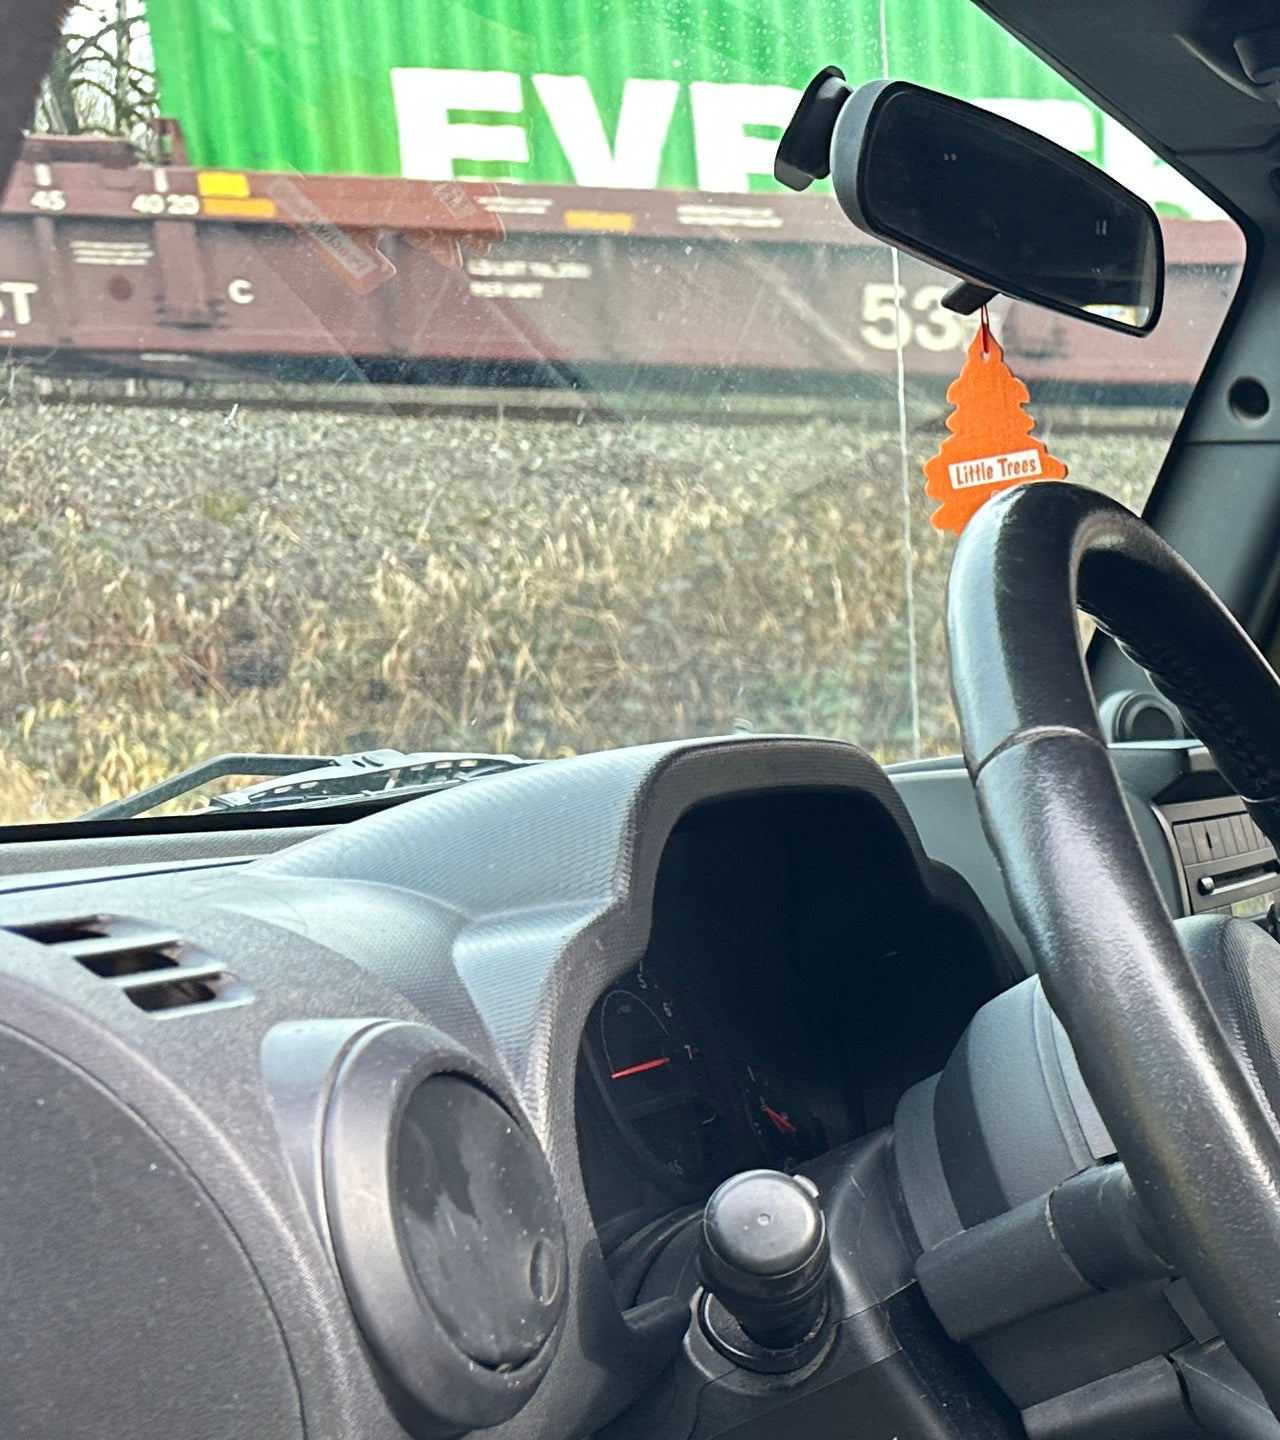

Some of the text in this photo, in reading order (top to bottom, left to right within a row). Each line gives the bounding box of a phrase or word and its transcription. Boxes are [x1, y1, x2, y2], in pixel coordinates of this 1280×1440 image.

[228, 279, 254, 304] C
[861, 283, 962, 351] 53
[956, 458, 1036, 485] Little Trees
